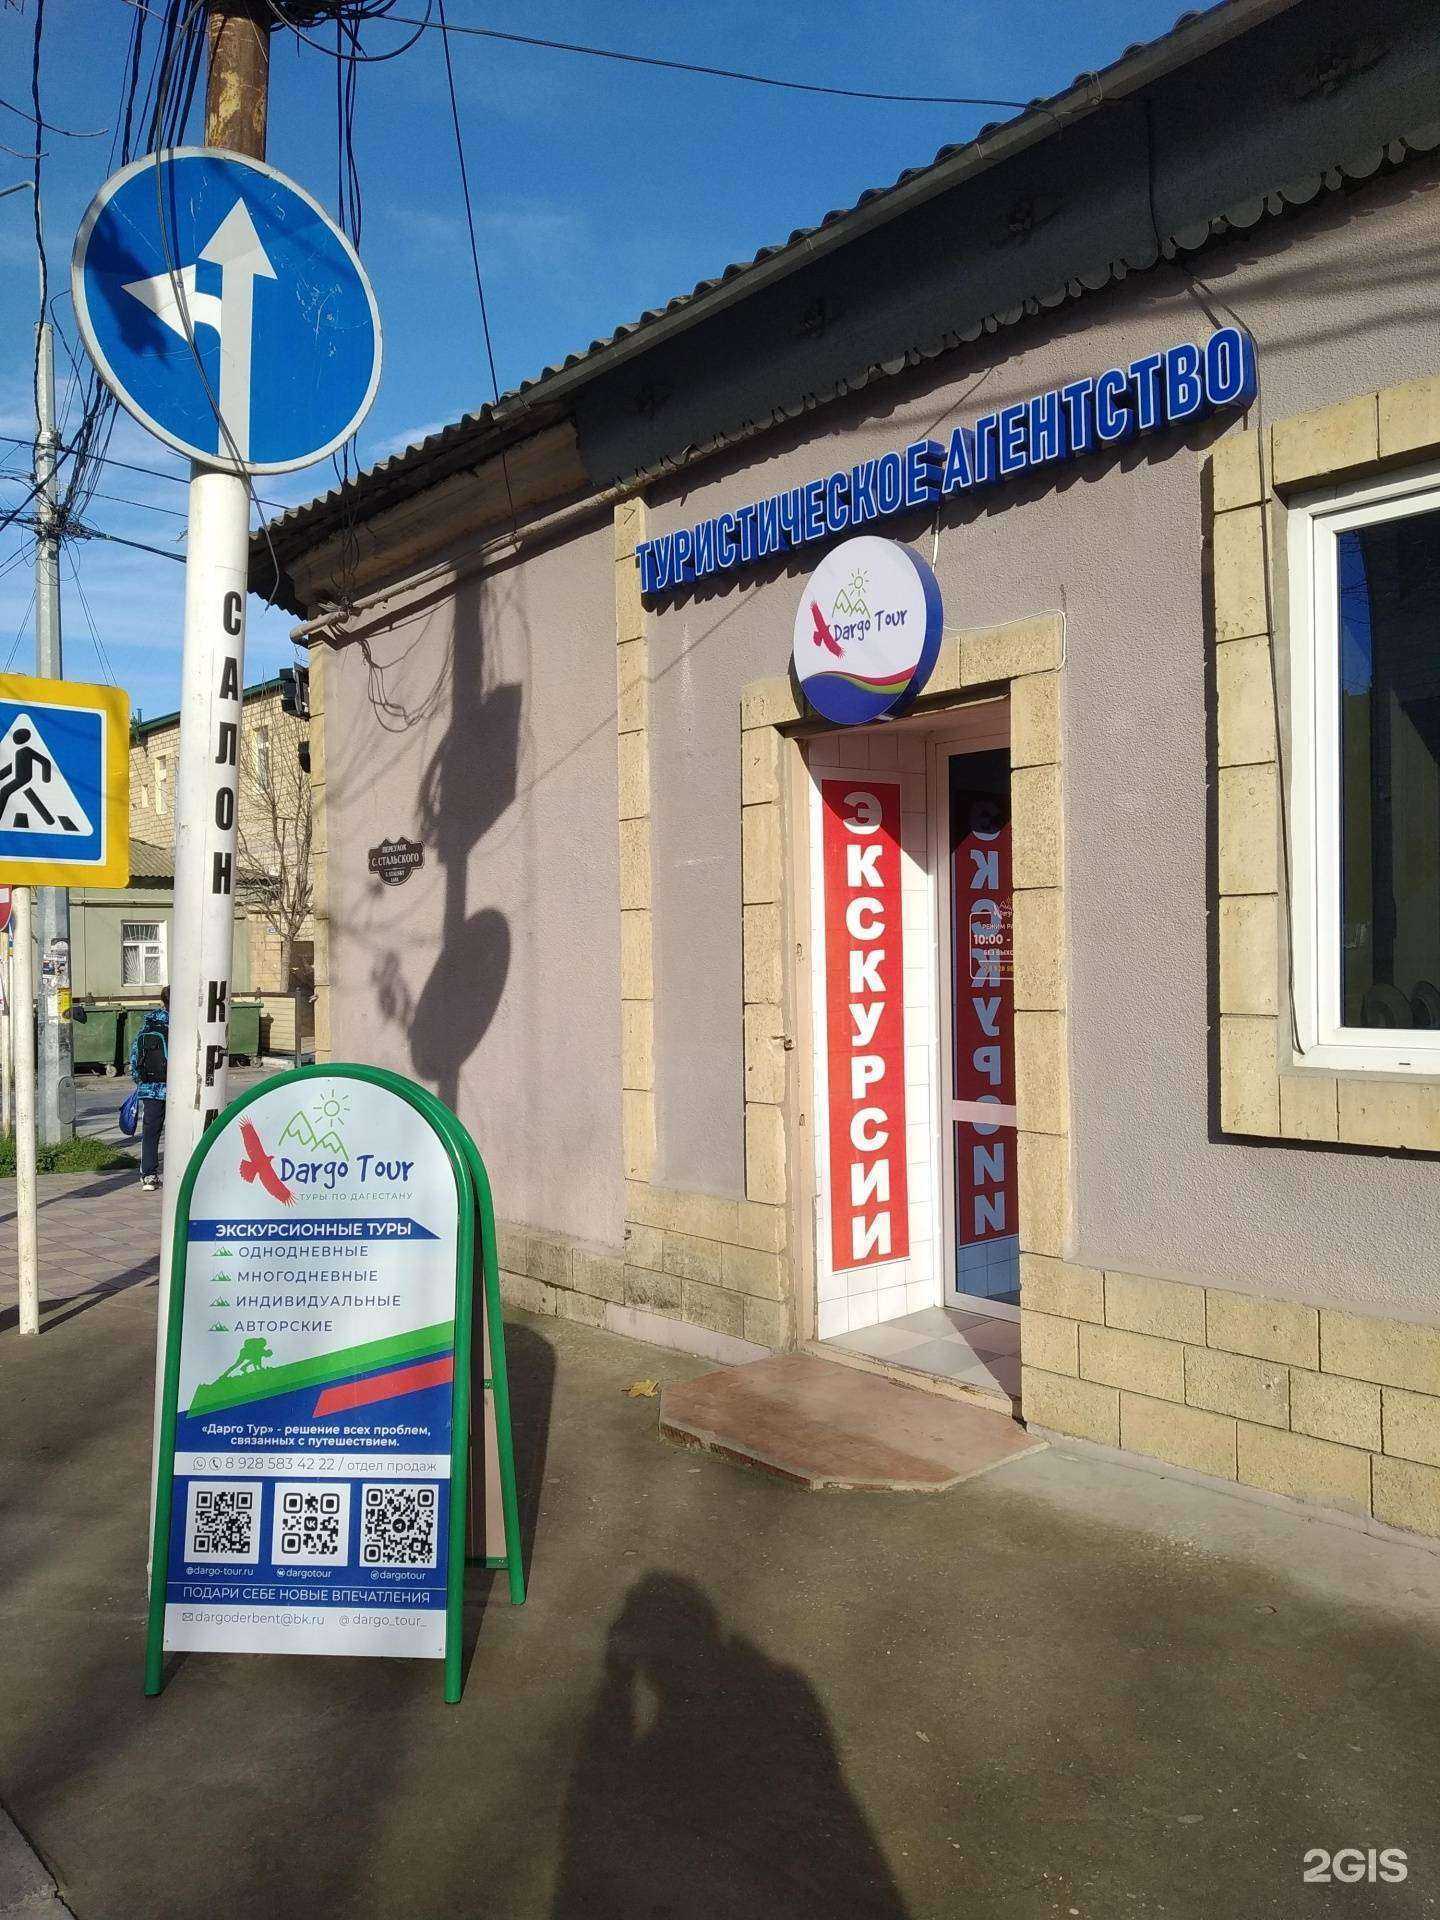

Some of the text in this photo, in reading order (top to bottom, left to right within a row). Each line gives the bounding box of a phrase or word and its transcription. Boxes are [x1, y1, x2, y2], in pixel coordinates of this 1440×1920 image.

[635, 326, 1248, 593] ТУРИСТИЧЕСКОЕ АГЕНТСТВО
[834, 610, 907, 641] Dargo Tour
[212, 591, 242, 895] САЛОН
[973, 934, 1004, 945] 10:00
[843, 790, 891, 1260] ЭКСКУРСИИ
[280, 1154, 415, 1189] Dargo Tour
[300, 1192, 413, 1201] ТУРЫ ПО ДАГЕСТАНУ
[215, 1222, 412, 1238] ЭКСКУРСИОННЫЕ ТУРЫ
[238, 1245, 368, 1259] ОДНОДНЕВНЫЕ
[237, 1270, 379, 1284] МНОГОДНЕВНЫЕ
[236, 1295, 401, 1309] ИНДИВИДУАЛЬНЫЕ
[234, 1320, 333, 1332] АВТОРСКИЕ
[201, 1424, 244, 1435] «Дарго
[246, 1424, 274, 1436] Тур»
[284, 1425, 340, 1436] решение
[343, 1426, 371, 1435] всех
[373, 1424, 431, 1436] проблем,
[230, 1437, 400, 1448] связанных с путешествием.
[225, 1457, 234, 1469] 8
[238, 1457, 264, 1469] 928
[267, 1457, 293, 1470] 583
[297, 1458, 315, 1470] 42
[318, 1458, 335, 1470] 22
[347, 1461, 383, 1472] отдел
[387, 1462, 437, 1474] продаж
[183, 1586, 430, 1603] ПОДАРИ СЕБЕ НОВЫЕ ВПЕЧАТЛЕНИЯ
[195, 1612, 325, 1626] dargoderbent@bk.ru
